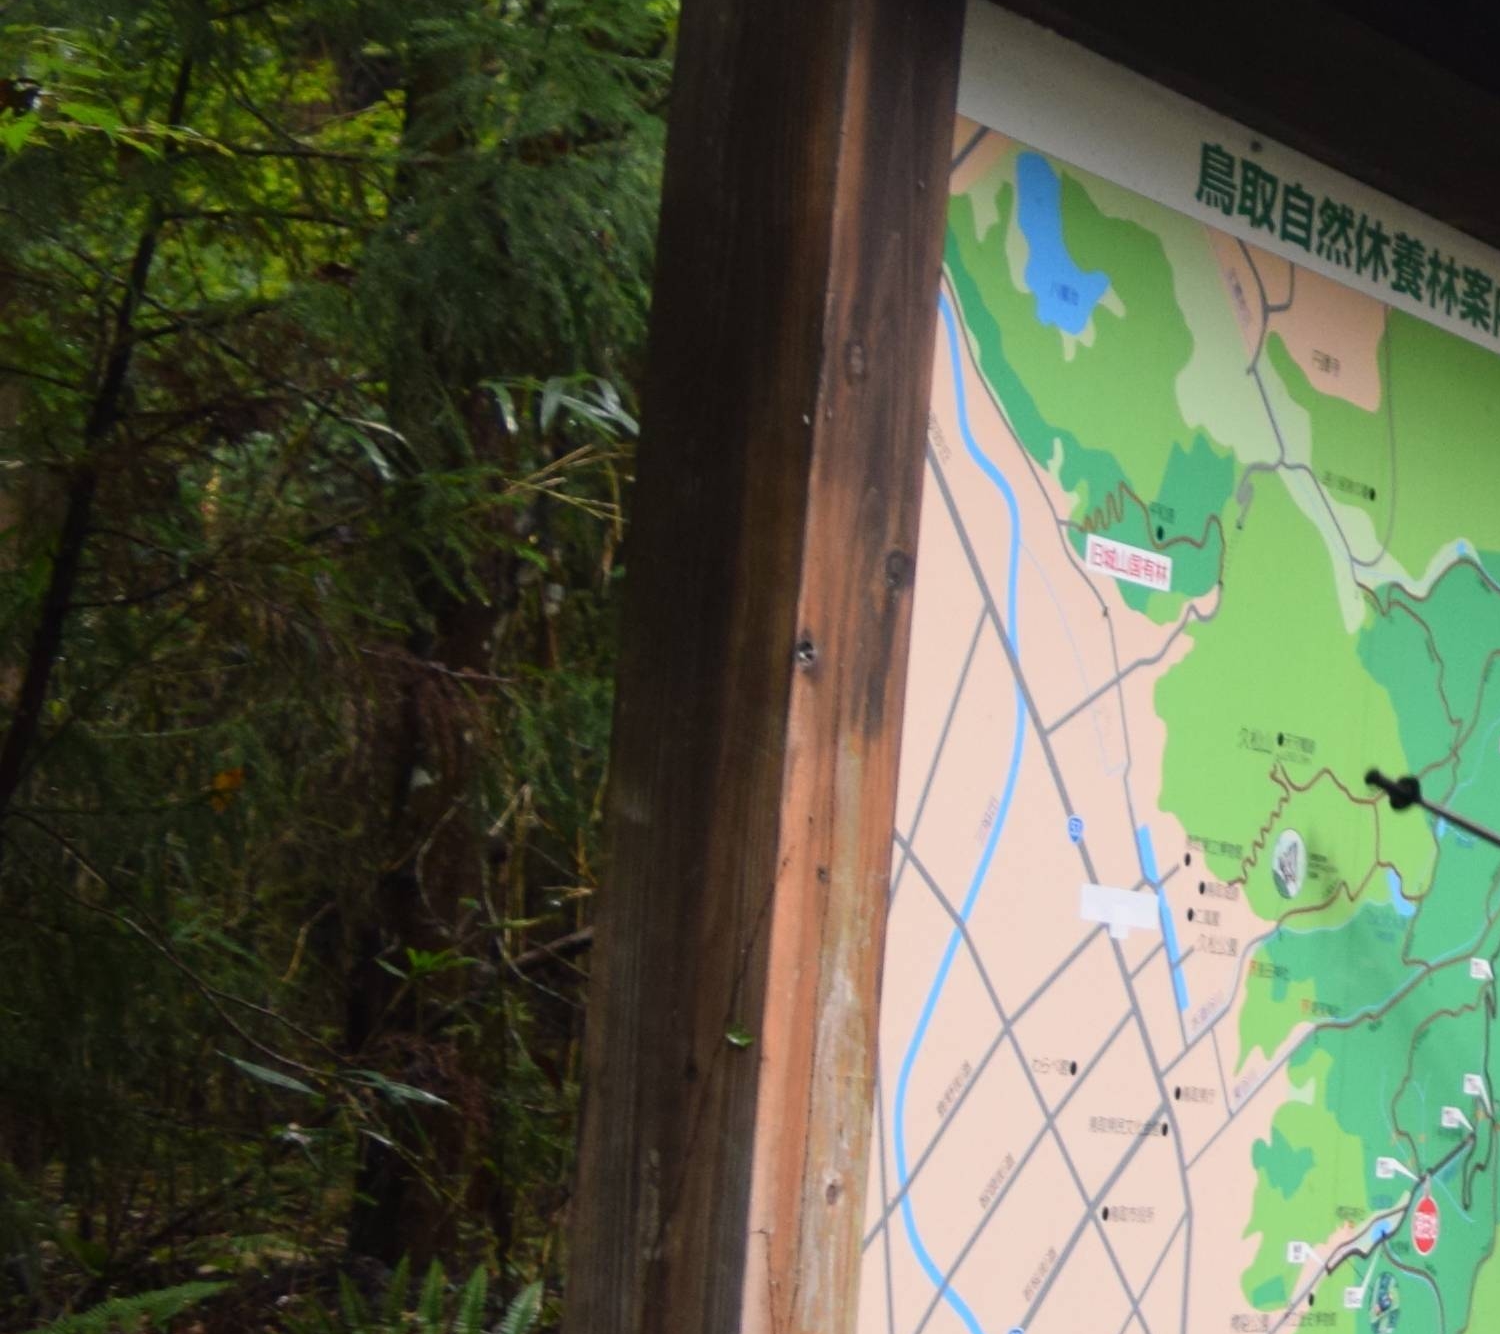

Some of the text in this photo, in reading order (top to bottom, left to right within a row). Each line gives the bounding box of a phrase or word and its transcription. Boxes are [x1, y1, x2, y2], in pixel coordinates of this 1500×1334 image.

[1090, 540, 1168, 586] 旧城山国有林
